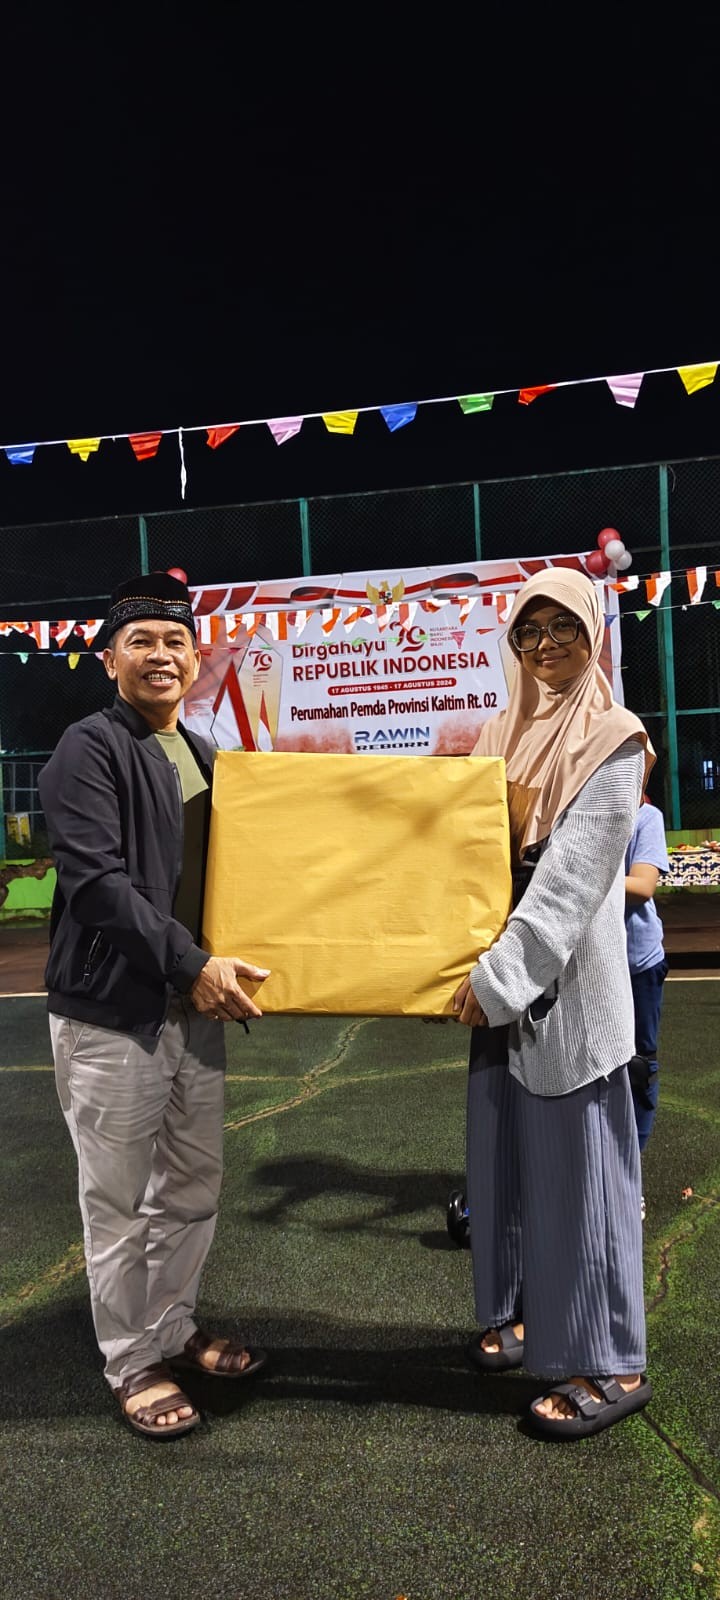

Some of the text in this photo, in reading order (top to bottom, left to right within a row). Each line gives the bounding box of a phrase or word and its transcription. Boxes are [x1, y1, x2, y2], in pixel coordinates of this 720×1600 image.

[292, 640, 386, 660] Dirgahayu
[293, 651, 490, 682] REPUBLIK INDONESIA
[341, 685, 372, 693] AGUSTUS
[403, 680, 435, 689] AGUSTUS
[290, 692, 498, 721] Perumahan Pemda Provinsi Kaltim Rt. 02
[354, 726, 430, 743] RAWIN
[356, 741, 430, 751] REBORN
